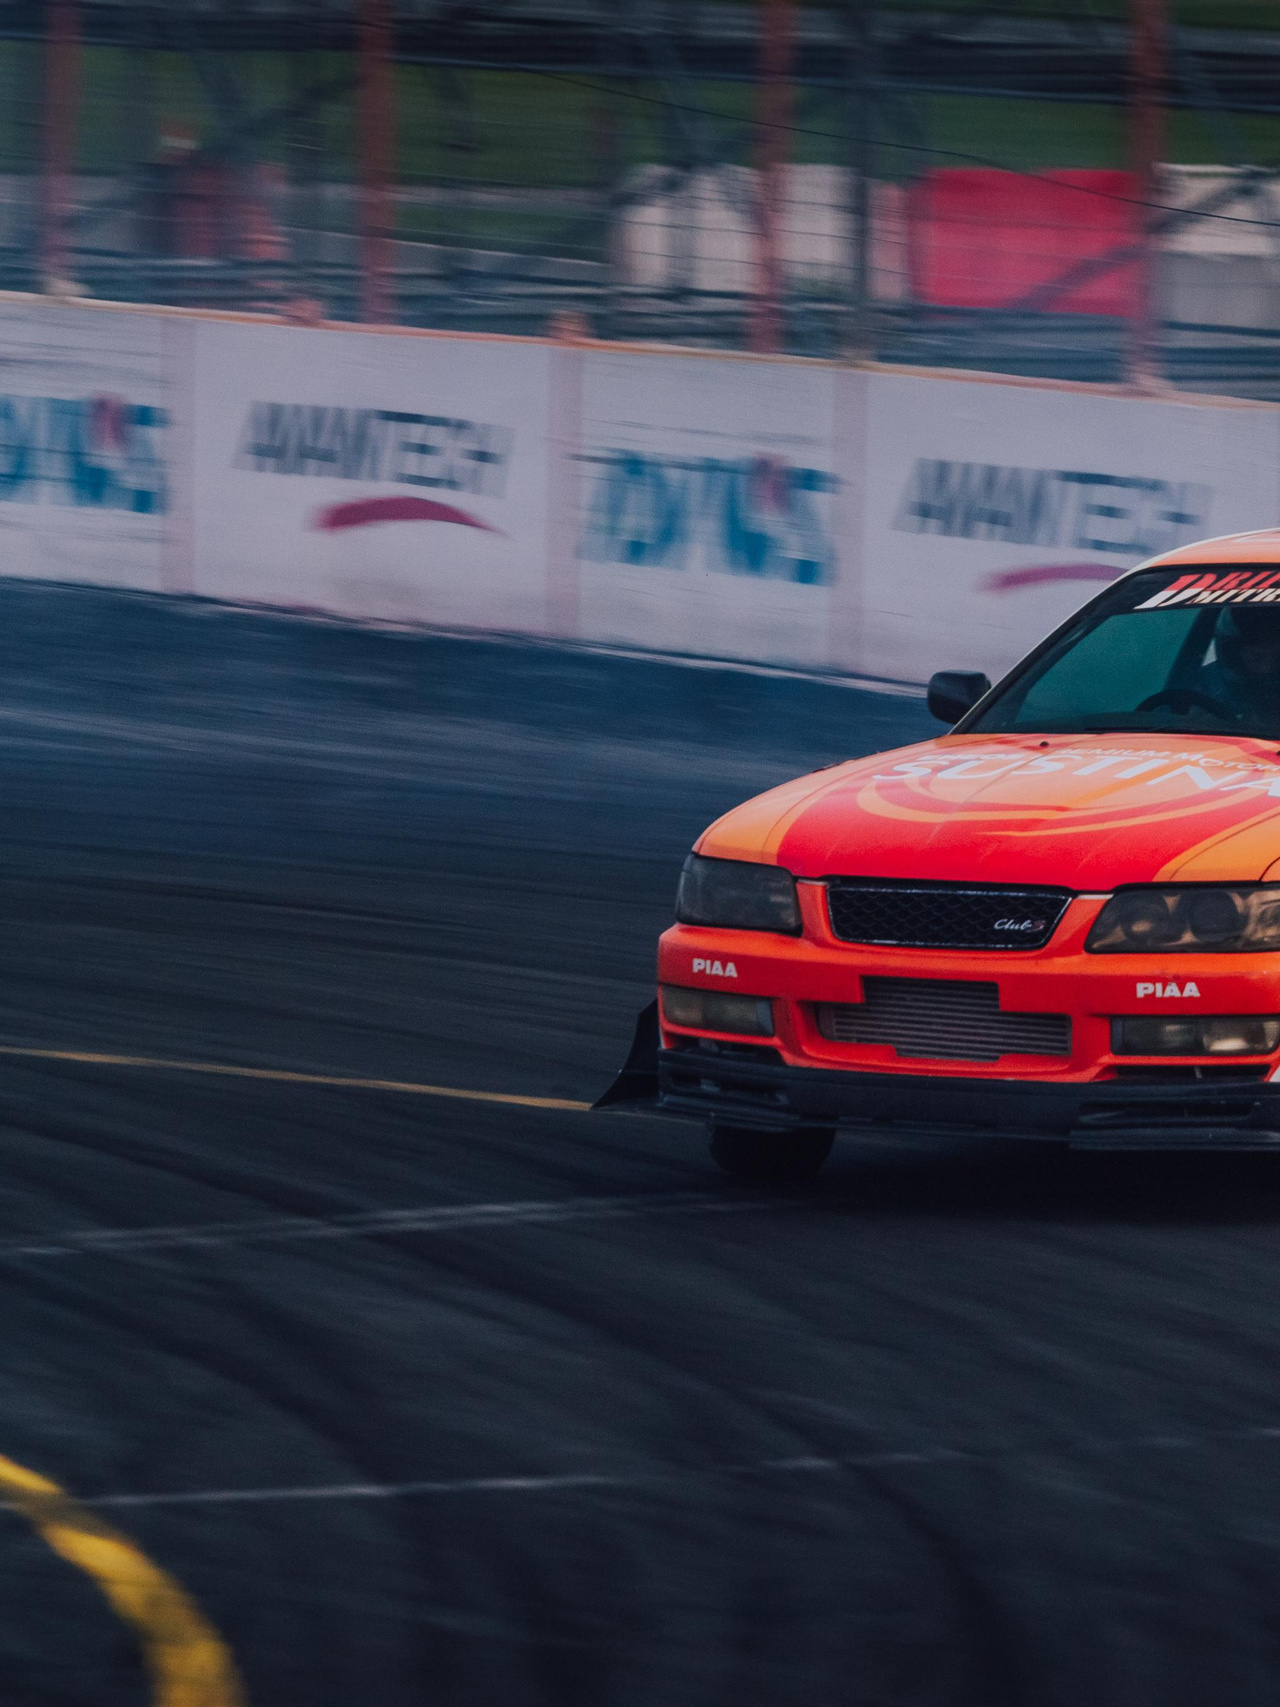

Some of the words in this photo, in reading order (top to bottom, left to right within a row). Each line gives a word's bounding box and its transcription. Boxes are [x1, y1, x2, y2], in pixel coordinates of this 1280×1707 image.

[994, 918, 1032, 930] Club
[692, 957, 738, 978] PIAA
[1136, 981, 1201, 998] PIAA
